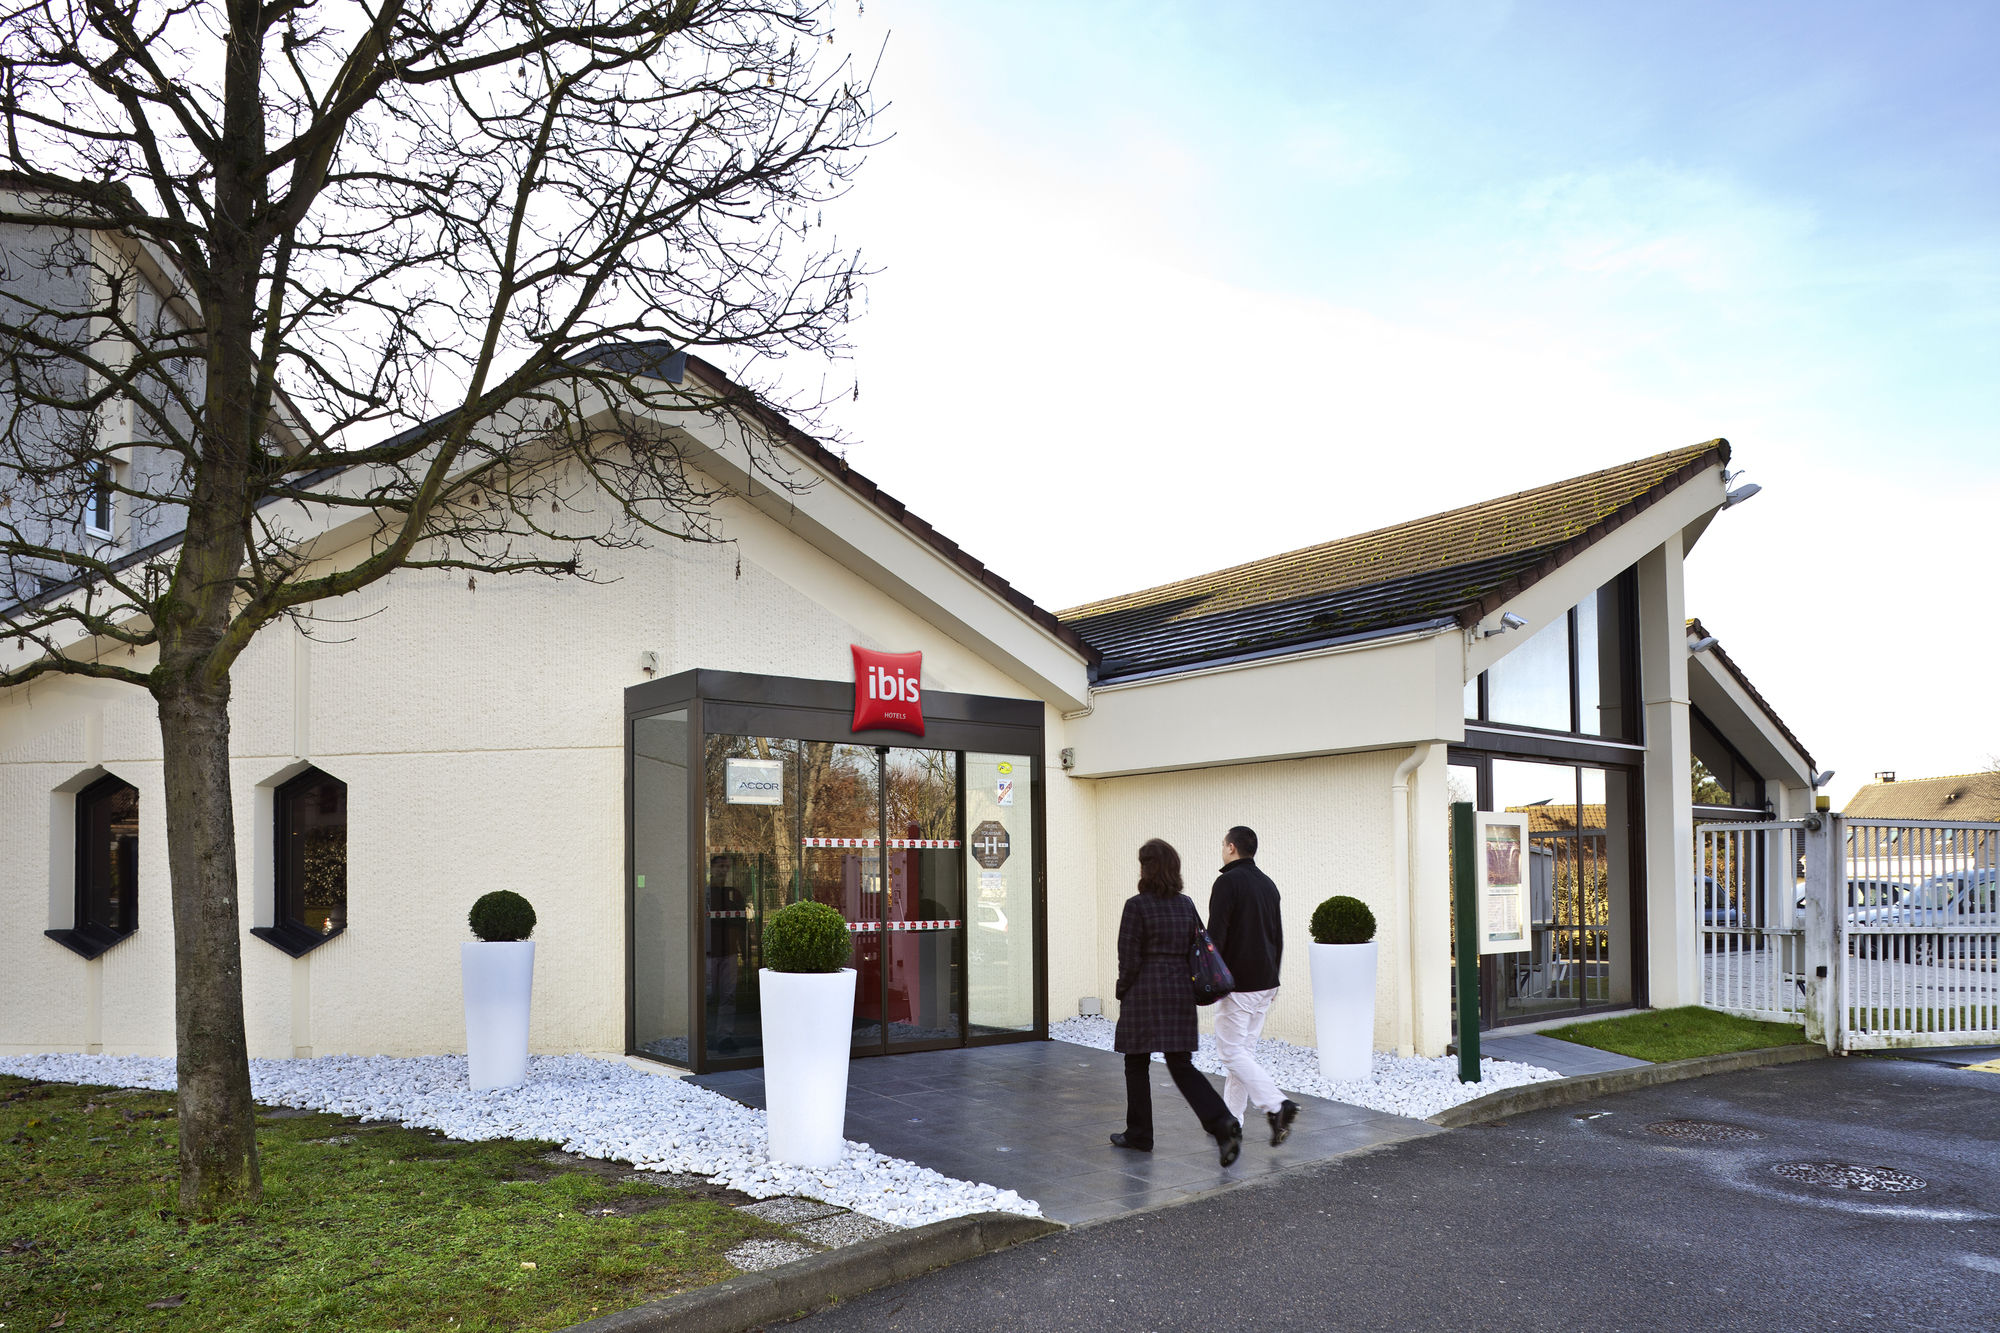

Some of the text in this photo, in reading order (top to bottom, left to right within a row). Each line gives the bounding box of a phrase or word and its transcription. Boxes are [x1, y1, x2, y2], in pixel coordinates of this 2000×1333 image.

[869, 666, 919, 703] ibis
[739, 782, 779, 790] ACCOR
[985, 837, 998, 855] H
